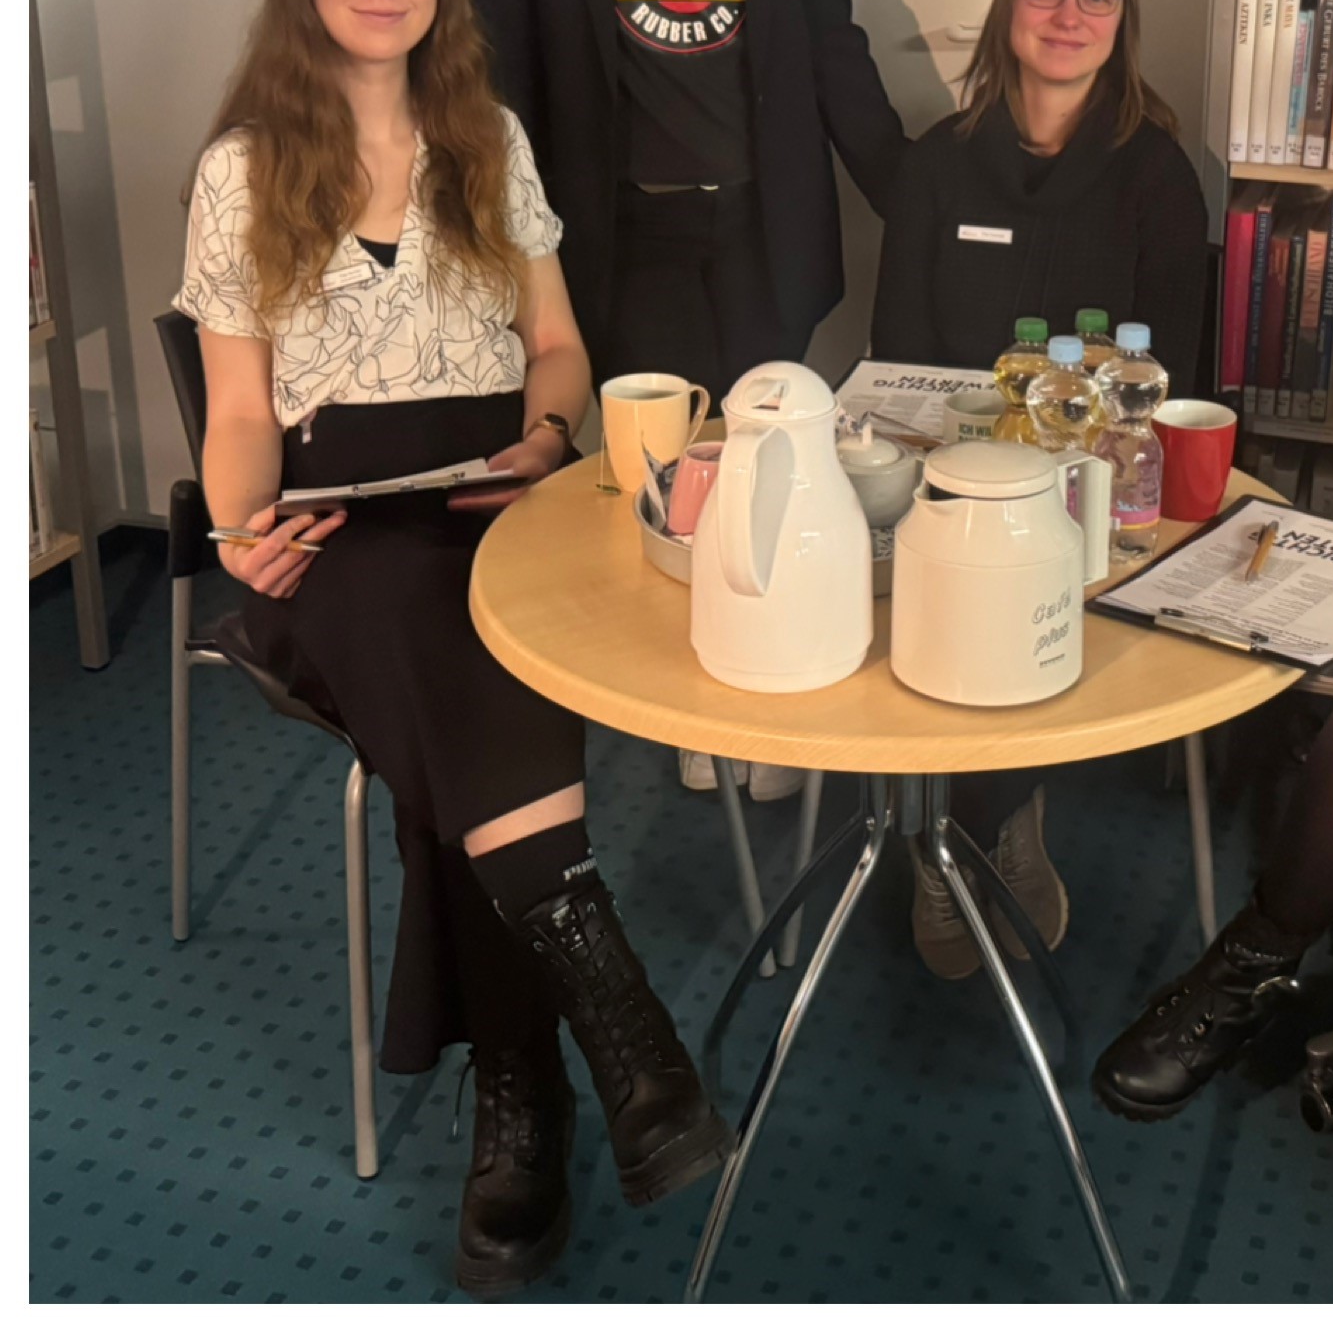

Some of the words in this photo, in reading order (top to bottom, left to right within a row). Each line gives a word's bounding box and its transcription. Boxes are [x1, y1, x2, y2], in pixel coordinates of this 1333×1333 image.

[630, 2, 708, 44] RUBBER
[709, 5, 739, 34] CO.
[1239, 1, 1249, 44] AZTEKEN
[1262, 3, 1273, 27] INKA
